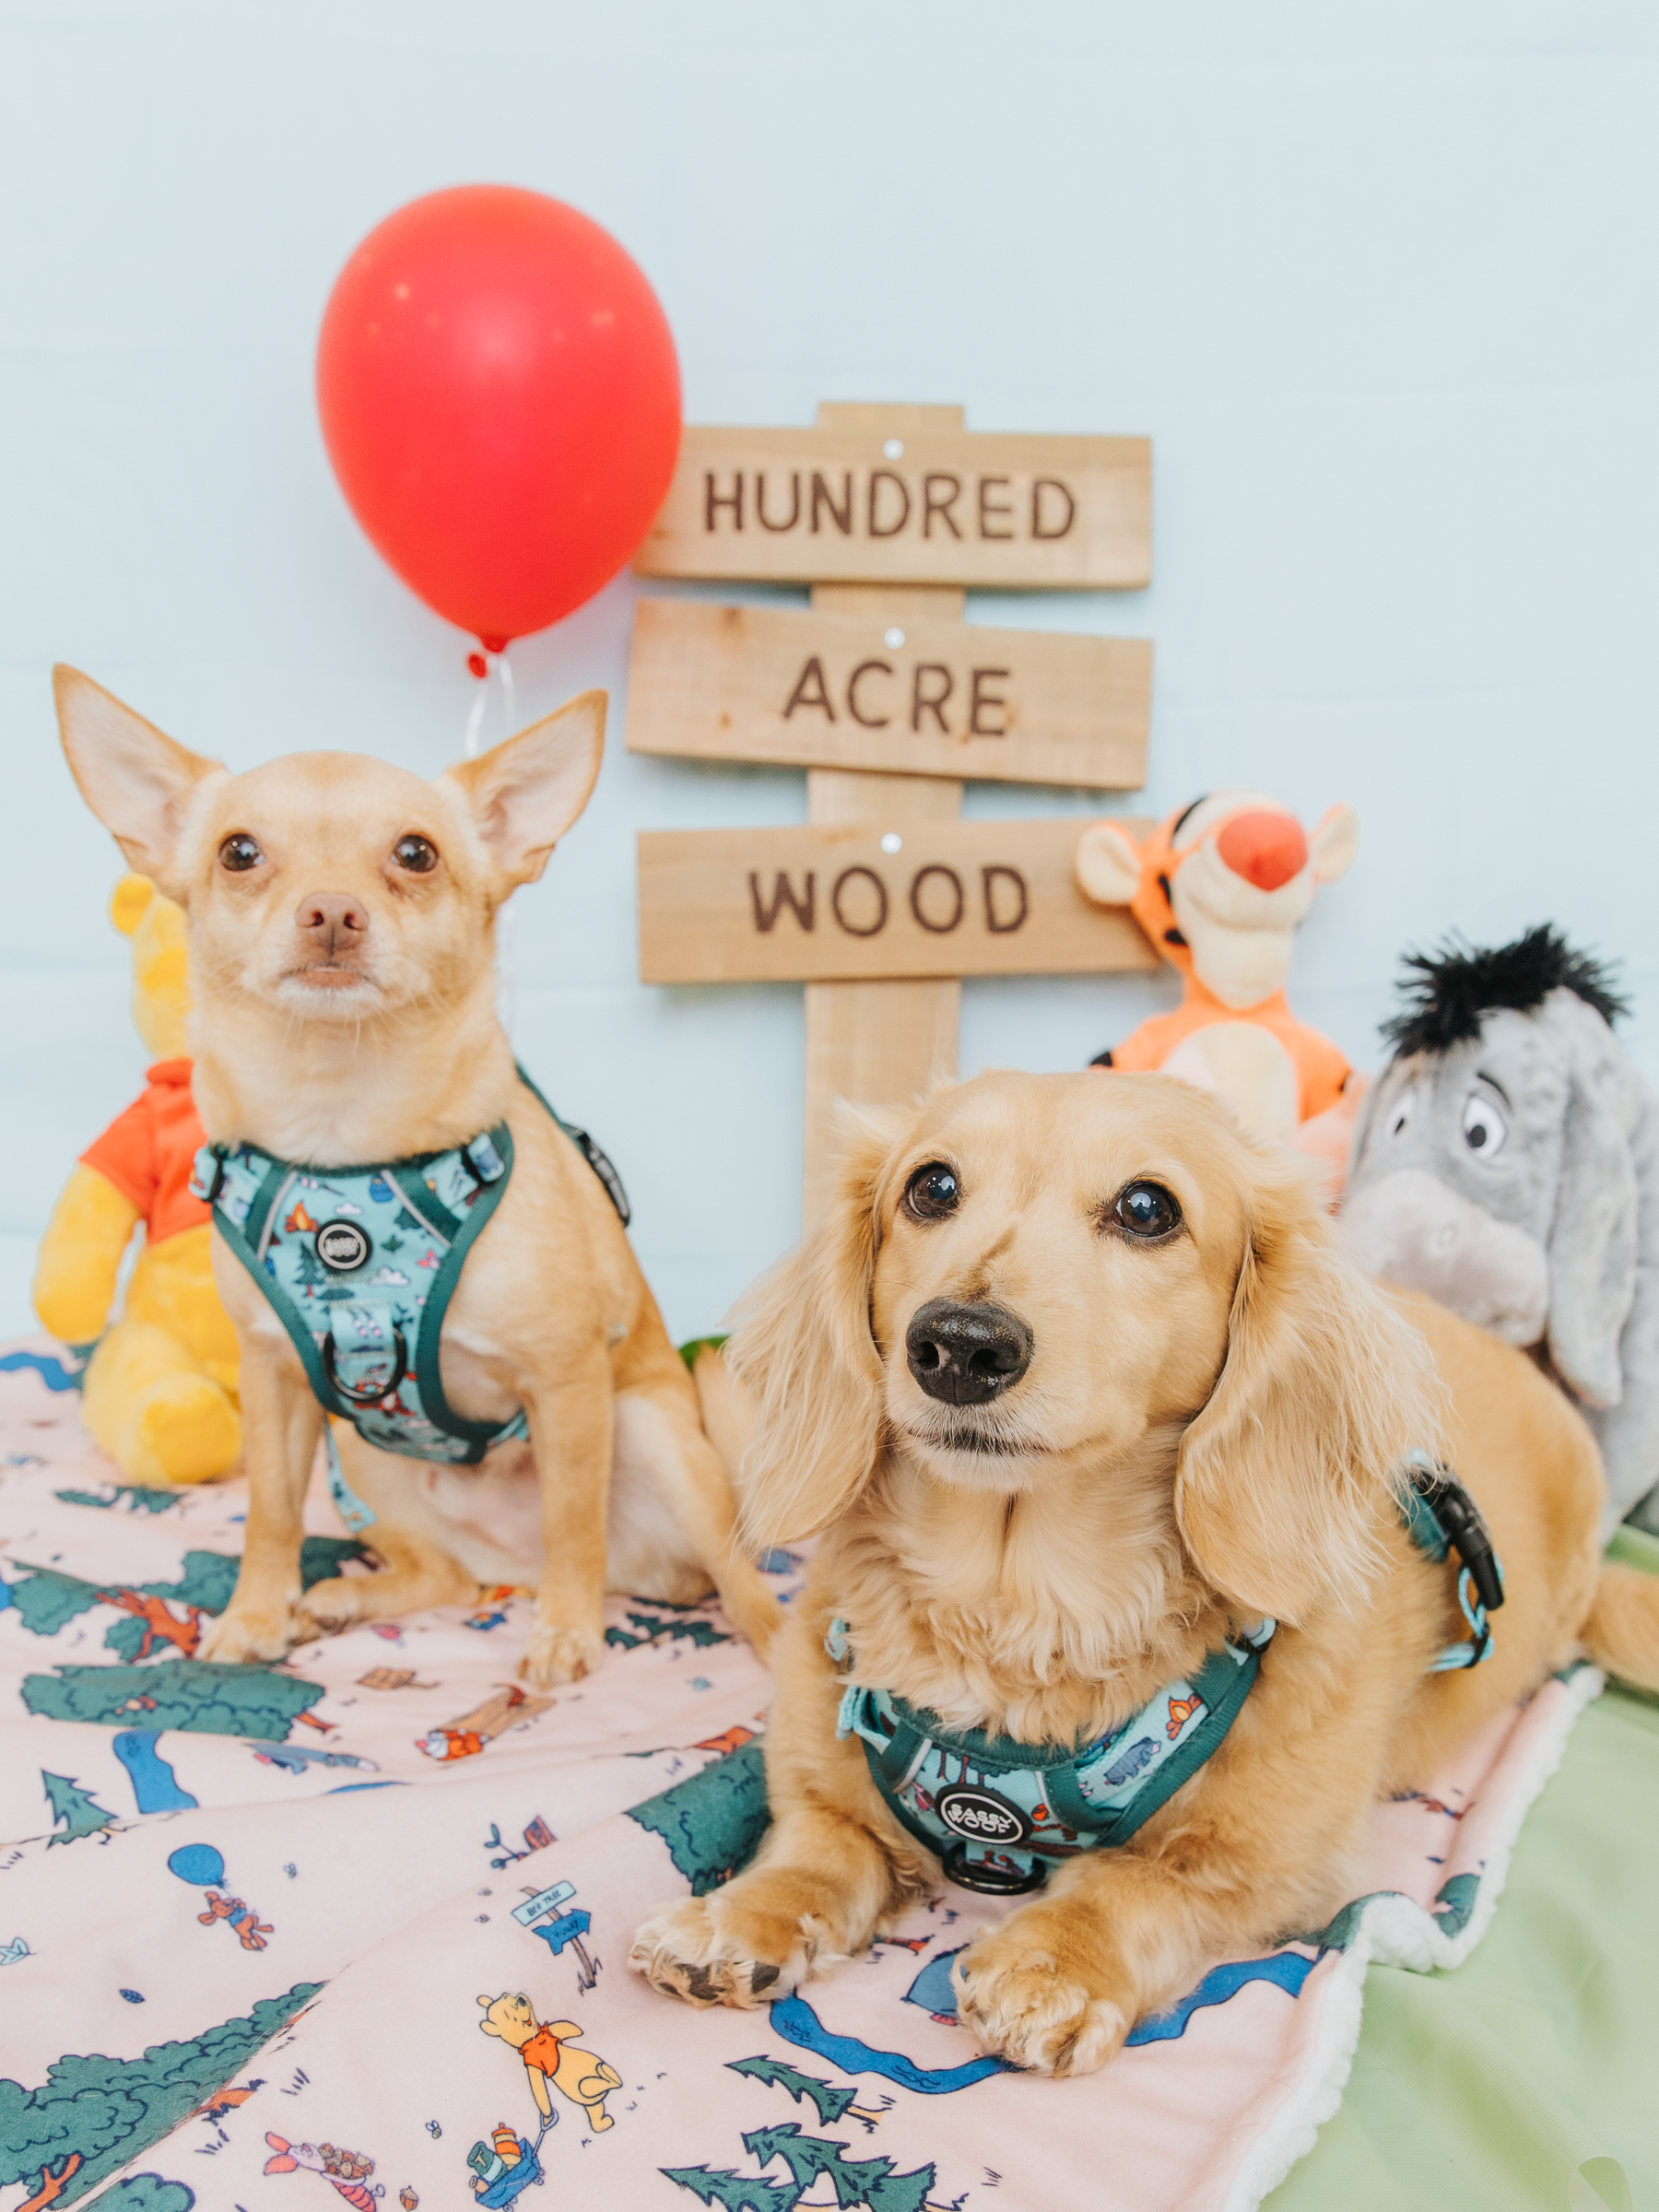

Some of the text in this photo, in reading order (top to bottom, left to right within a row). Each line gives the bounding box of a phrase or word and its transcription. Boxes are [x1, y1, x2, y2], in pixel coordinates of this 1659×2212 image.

[704, 470, 1077, 541] HUNDRED
[782, 654, 1011, 737] ACRE
[748, 864, 1030, 938] WOOD
[947, 1809, 1011, 1834] WOOF
[949, 1803, 1013, 1826] SASSY
